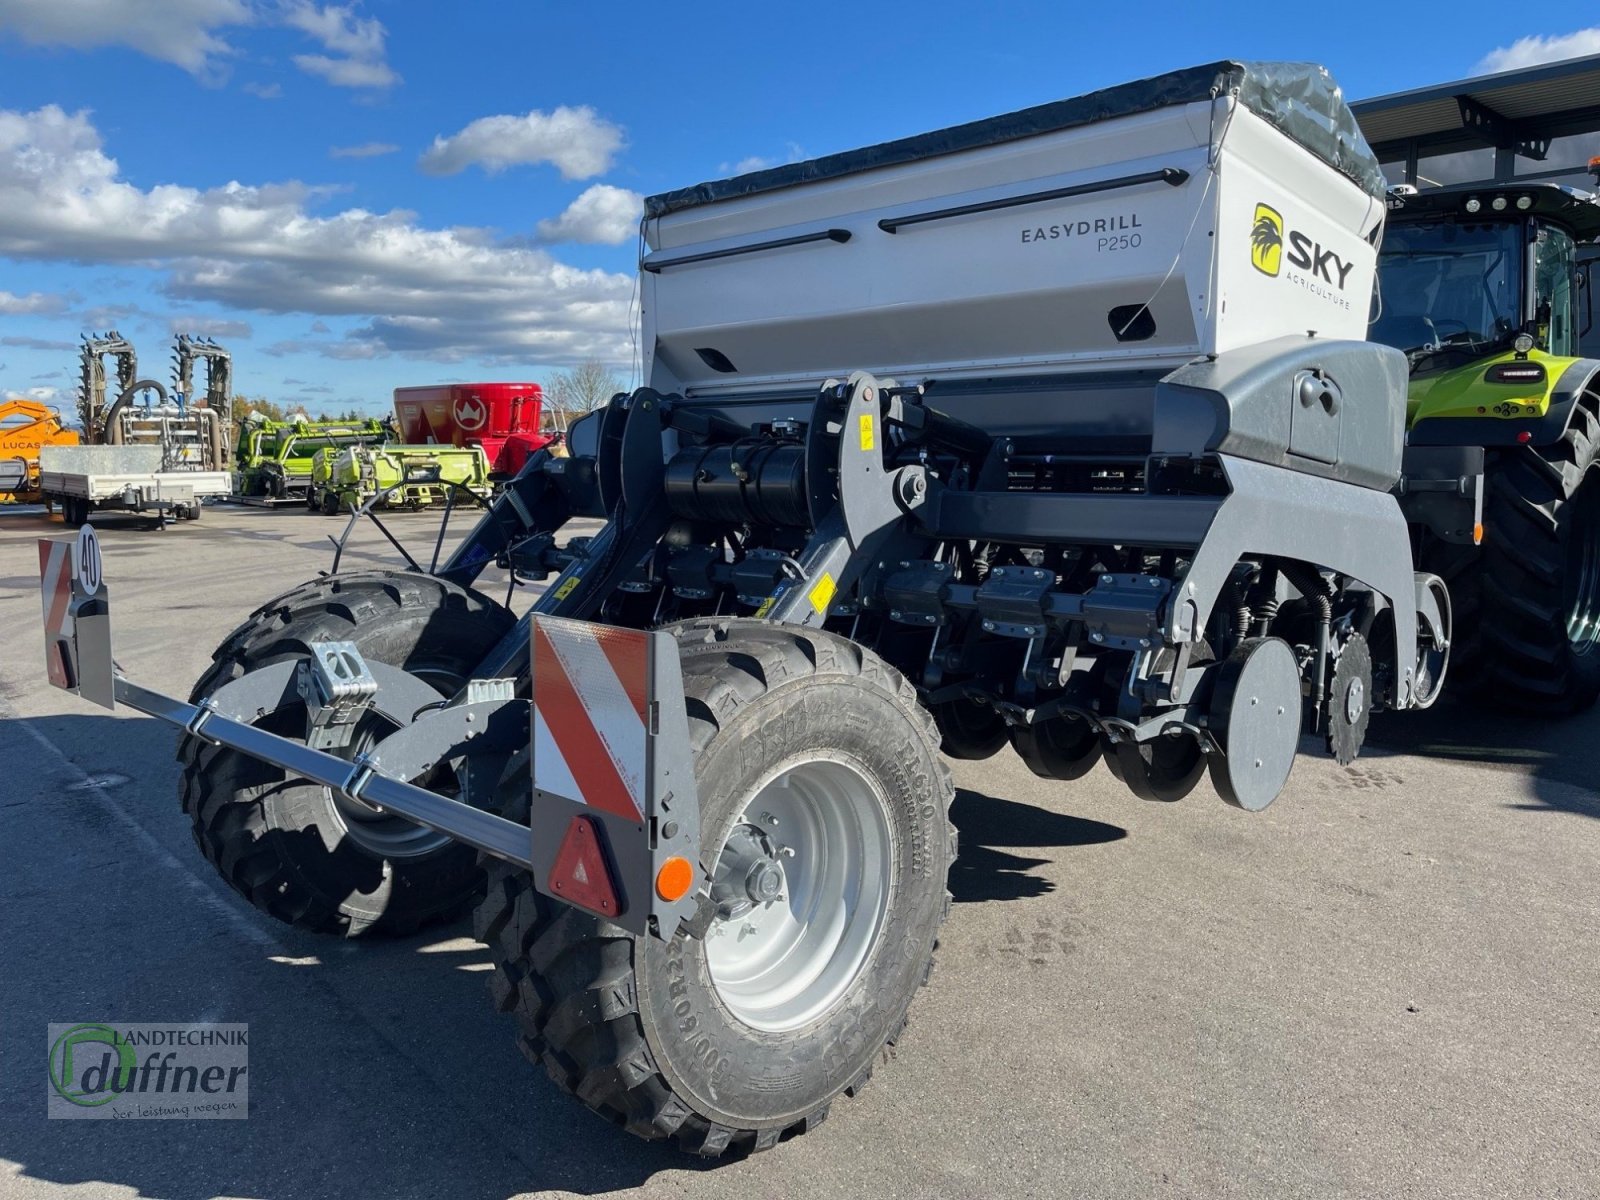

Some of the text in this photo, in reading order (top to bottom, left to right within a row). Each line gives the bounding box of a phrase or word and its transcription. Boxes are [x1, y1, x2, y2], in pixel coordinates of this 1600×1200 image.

[1021, 213, 1143, 244] EASYDRILL
[1097, 233, 1143, 252] P250
[1286, 229, 1354, 292] SKY
[1286, 273, 1350, 311] AGRICULTURE
[3, 441, 40, 449] LUCAS
[81, 534, 97, 588] 40
